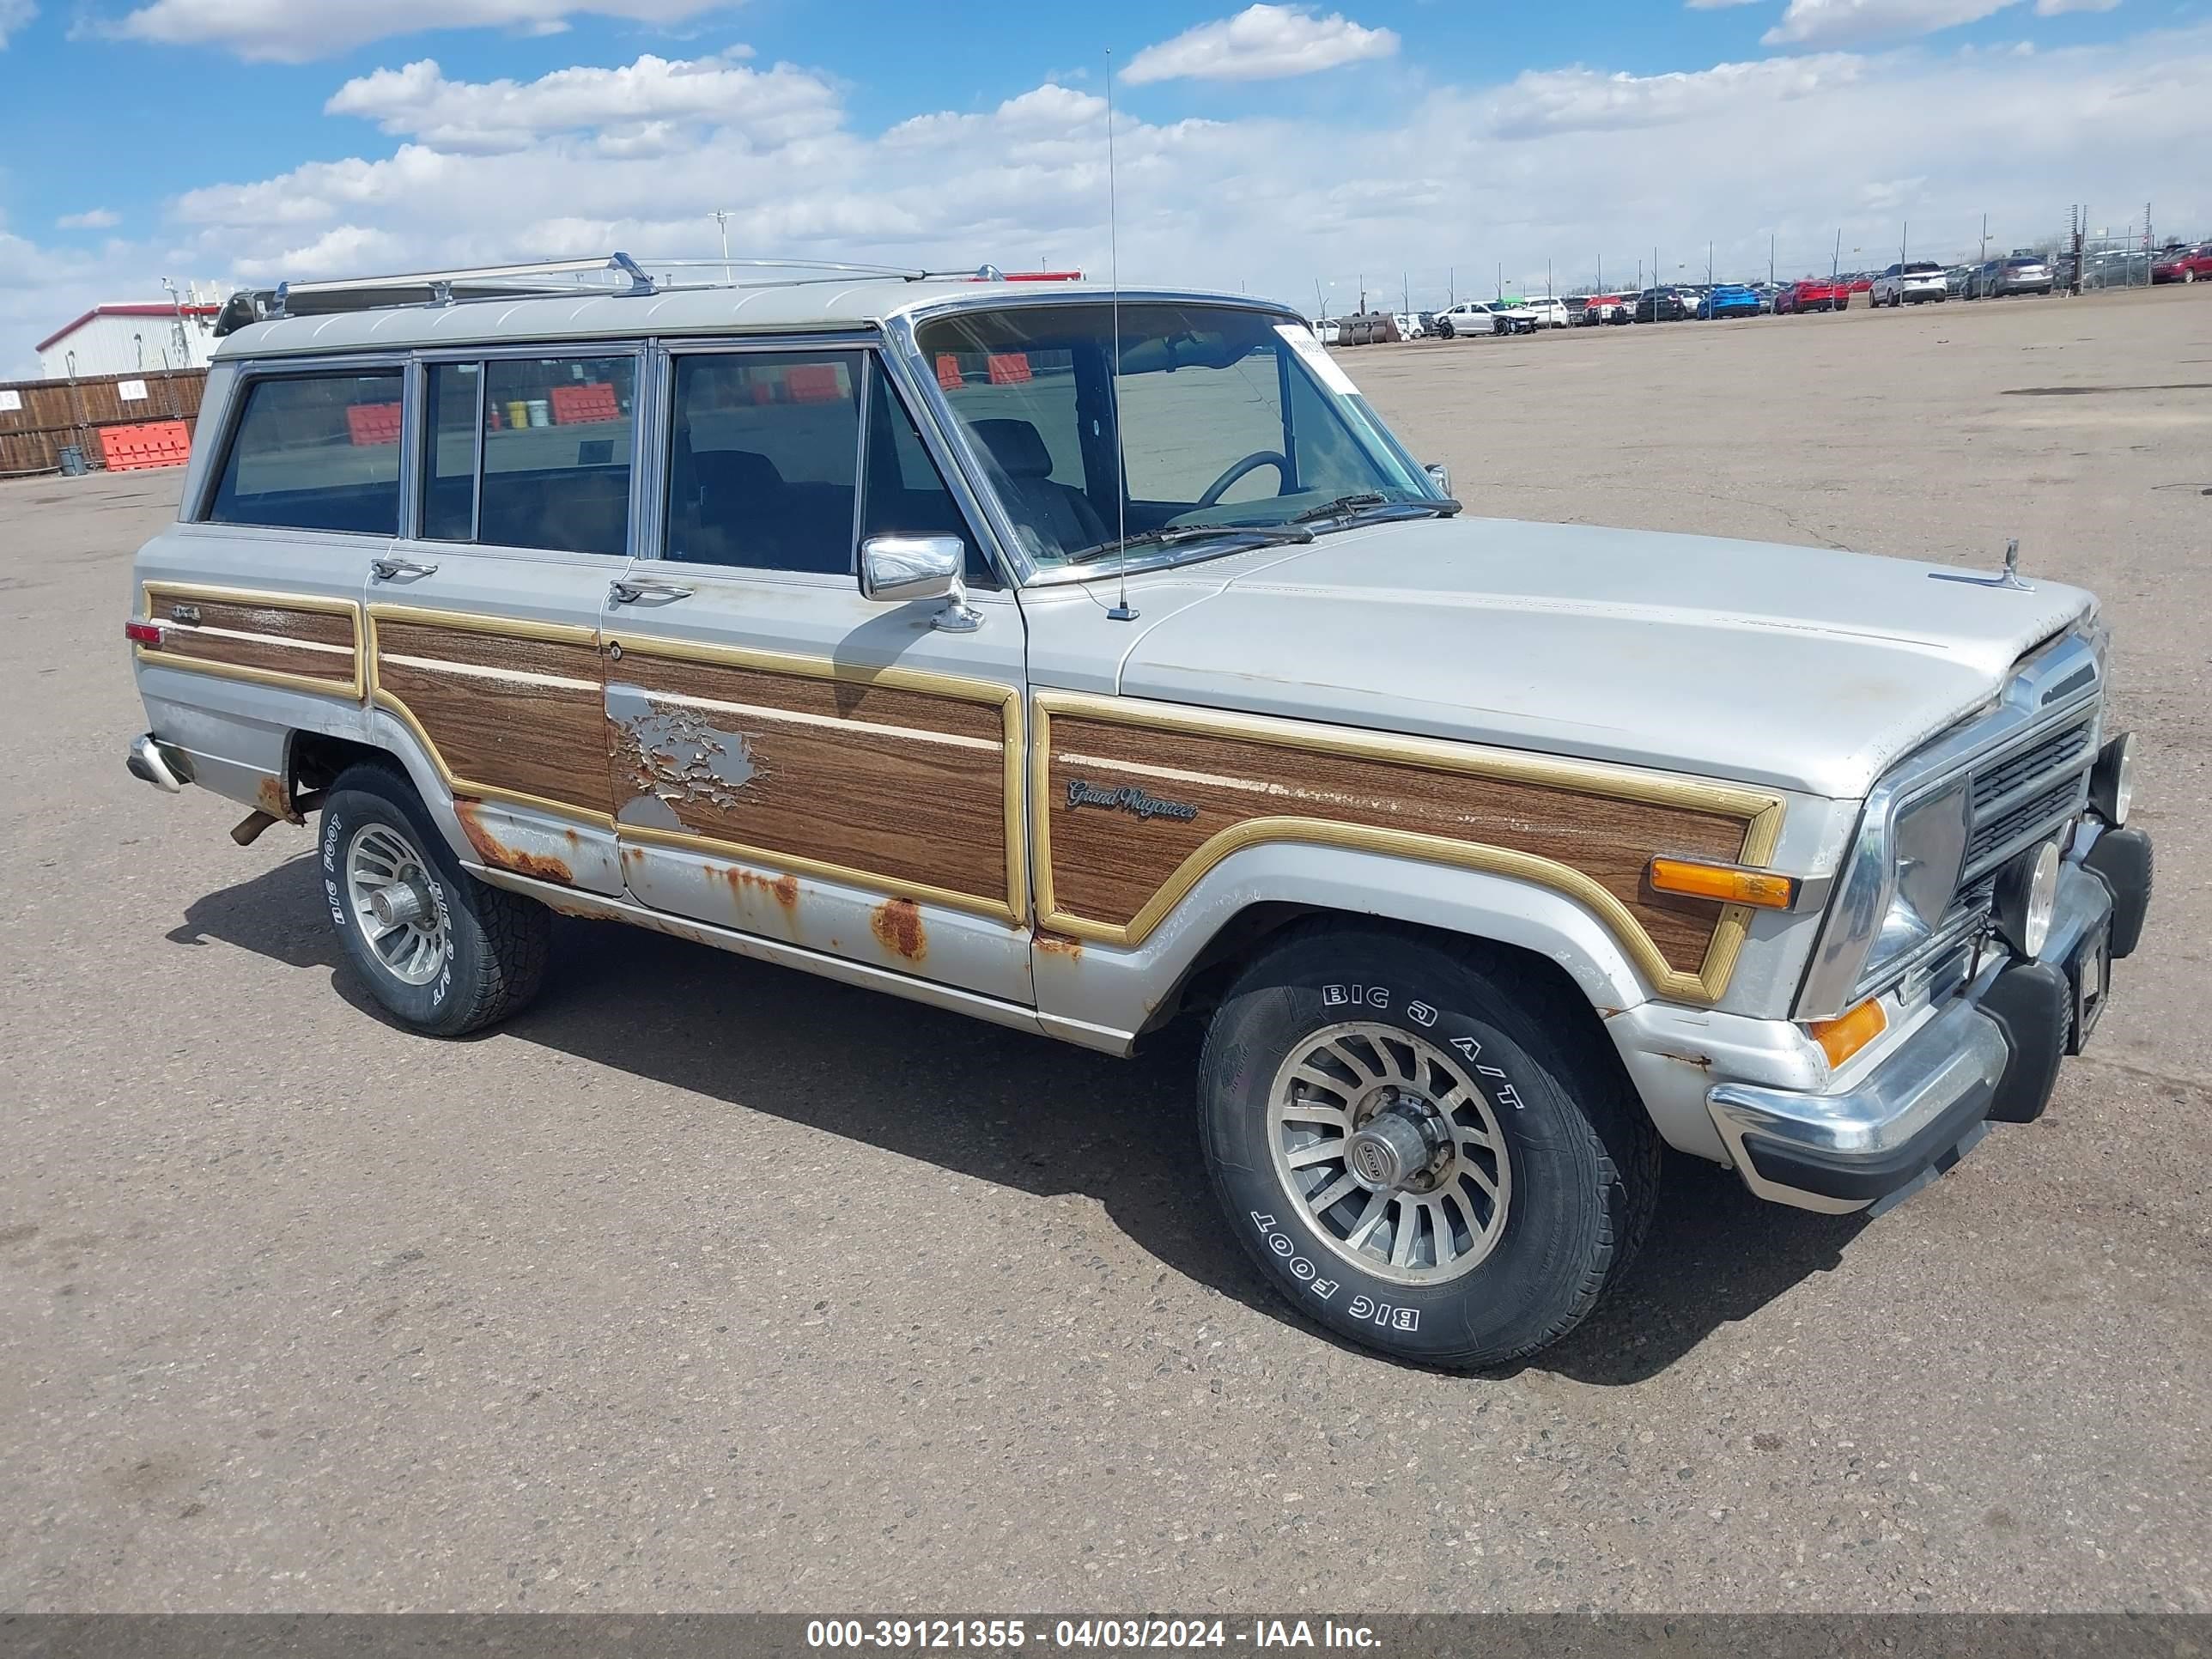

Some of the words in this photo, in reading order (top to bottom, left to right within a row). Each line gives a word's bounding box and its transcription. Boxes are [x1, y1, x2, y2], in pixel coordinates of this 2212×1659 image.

[125, 383, 143, 397] 14
[1066, 780, 1120, 806] Grand
[1120, 787, 1199, 817] Wagoneer
[324, 813, 342, 872] FOOT
[325, 878, 345, 925] BIG
[1322, 984, 1389, 1009] BIG
[1449, 1036, 1525, 1110] A/T
[1364, 1146, 1381, 1177] Jeep
[1250, 1211, 1340, 1300] FOOT
[1348, 1295, 1420, 1331] BIG
